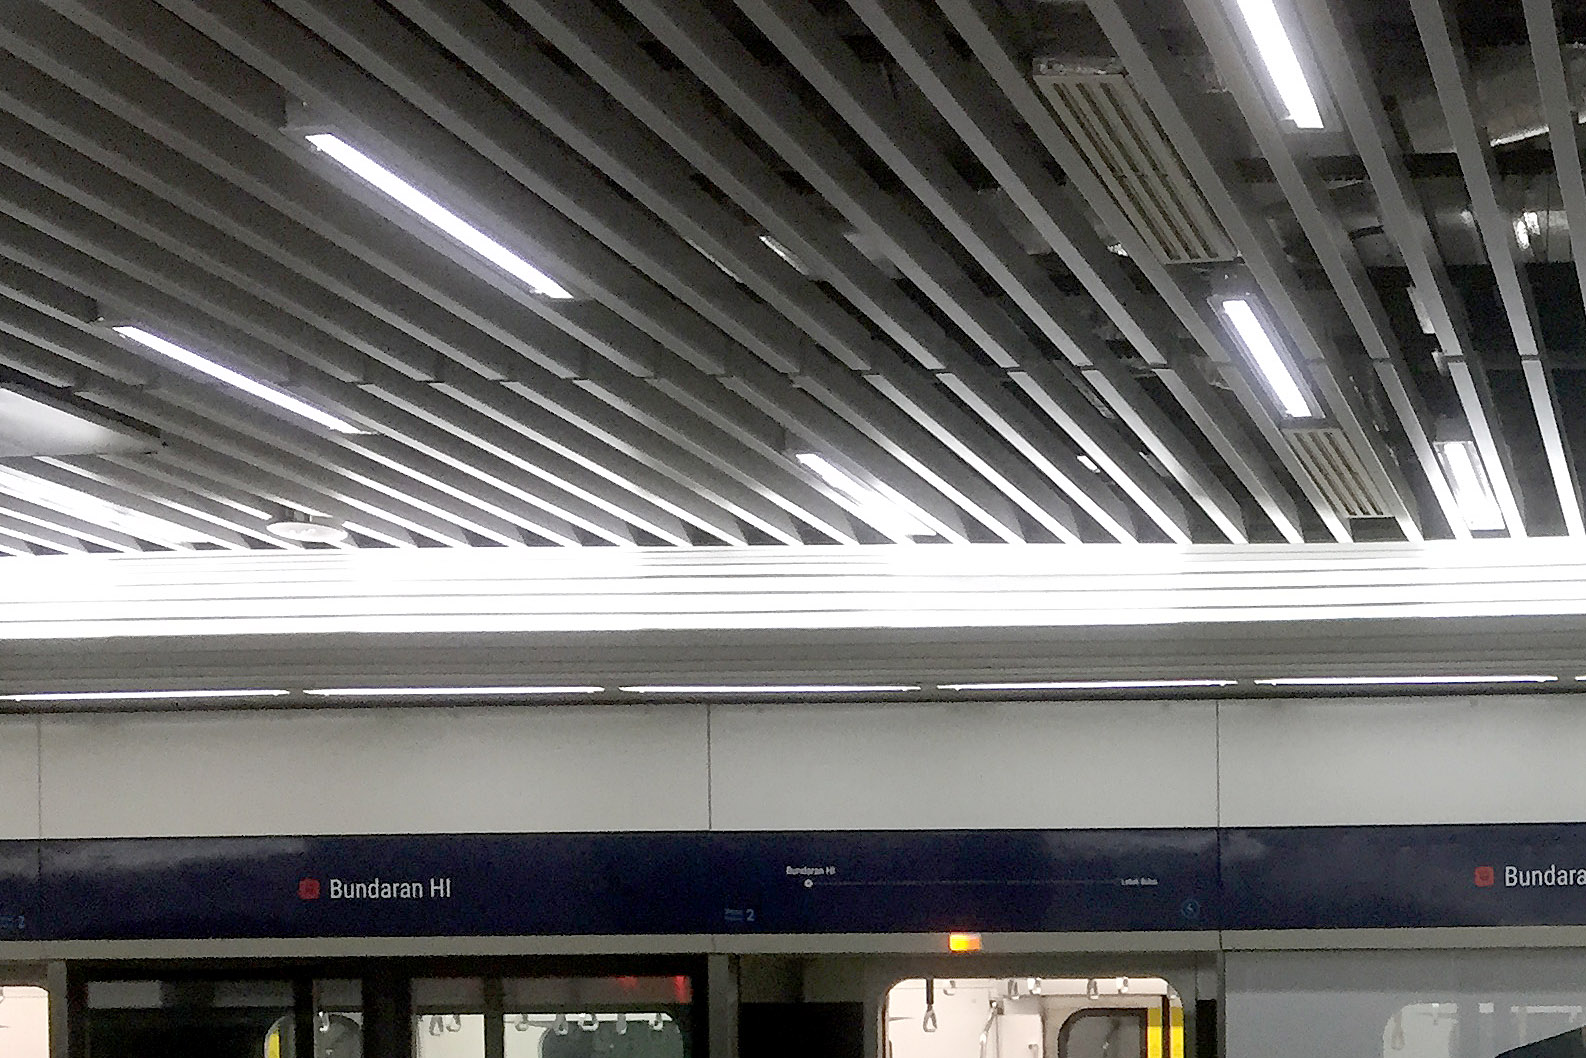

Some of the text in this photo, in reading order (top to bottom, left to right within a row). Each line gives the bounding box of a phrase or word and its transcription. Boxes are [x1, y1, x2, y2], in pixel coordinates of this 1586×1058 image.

[329, 877, 451, 899] Bundaran HI
[746, 908, 755, 921] 2
